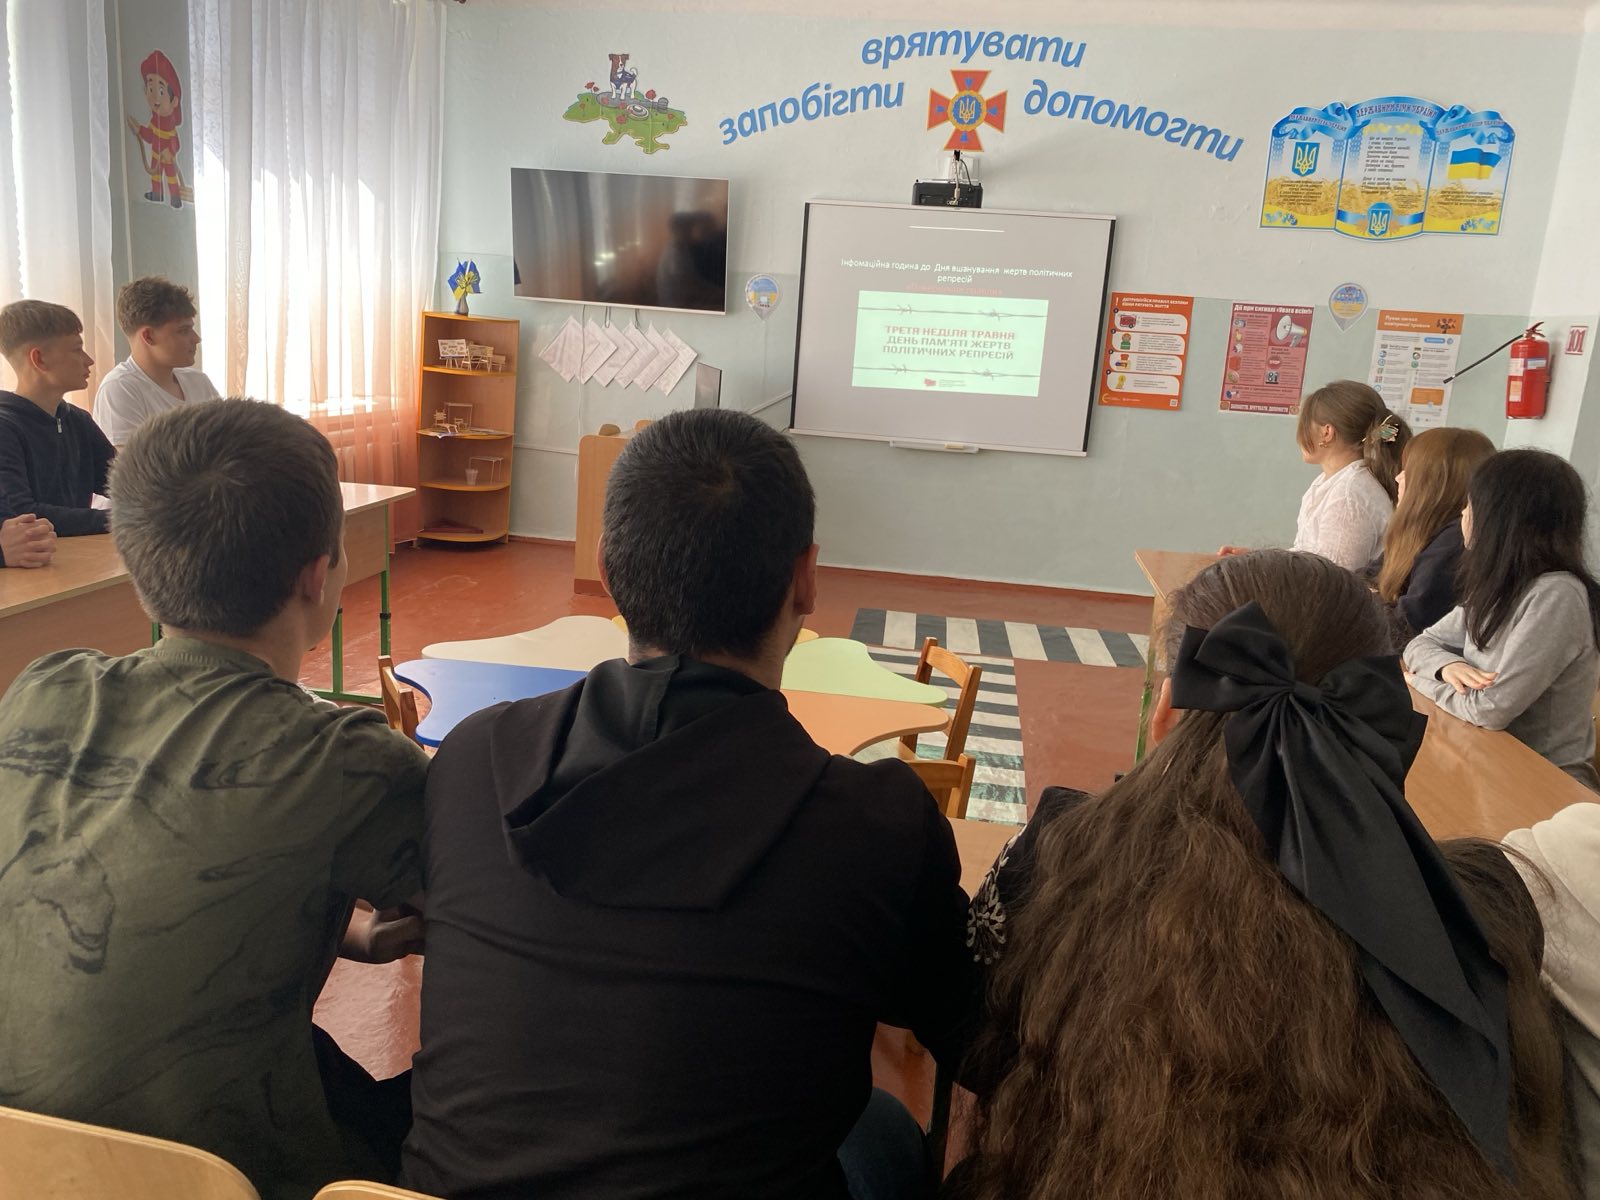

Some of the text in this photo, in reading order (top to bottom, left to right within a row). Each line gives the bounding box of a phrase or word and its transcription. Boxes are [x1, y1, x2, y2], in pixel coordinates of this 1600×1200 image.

[861, 29, 1087, 69] врятувати
[719, 82, 905, 146] запобігти
[1023, 78, 1244, 162] допомогти
[891, 261, 919, 271] година
[919, 263, 931, 272] до
[933, 263, 950, 273] Дня
[951, 265, 1000, 275] вшанування
[1003, 267, 1027, 277] жертв
[1028, 268, 1073, 279] політичних
[937, 274, 973, 284] репресій
[885, 325, 1016, 340] ТРЕТЯ НЕДІЛЯ ТРАВНЯ
[1566, 329, 1586, 353] 101
[886, 335, 918, 345] ДЕНЬ
[971, 341, 1011, 350] ЖЕРТВ
[882, 345, 1014, 360] ПОЛІТИЧНИХ РЕПРЕСІЙ
